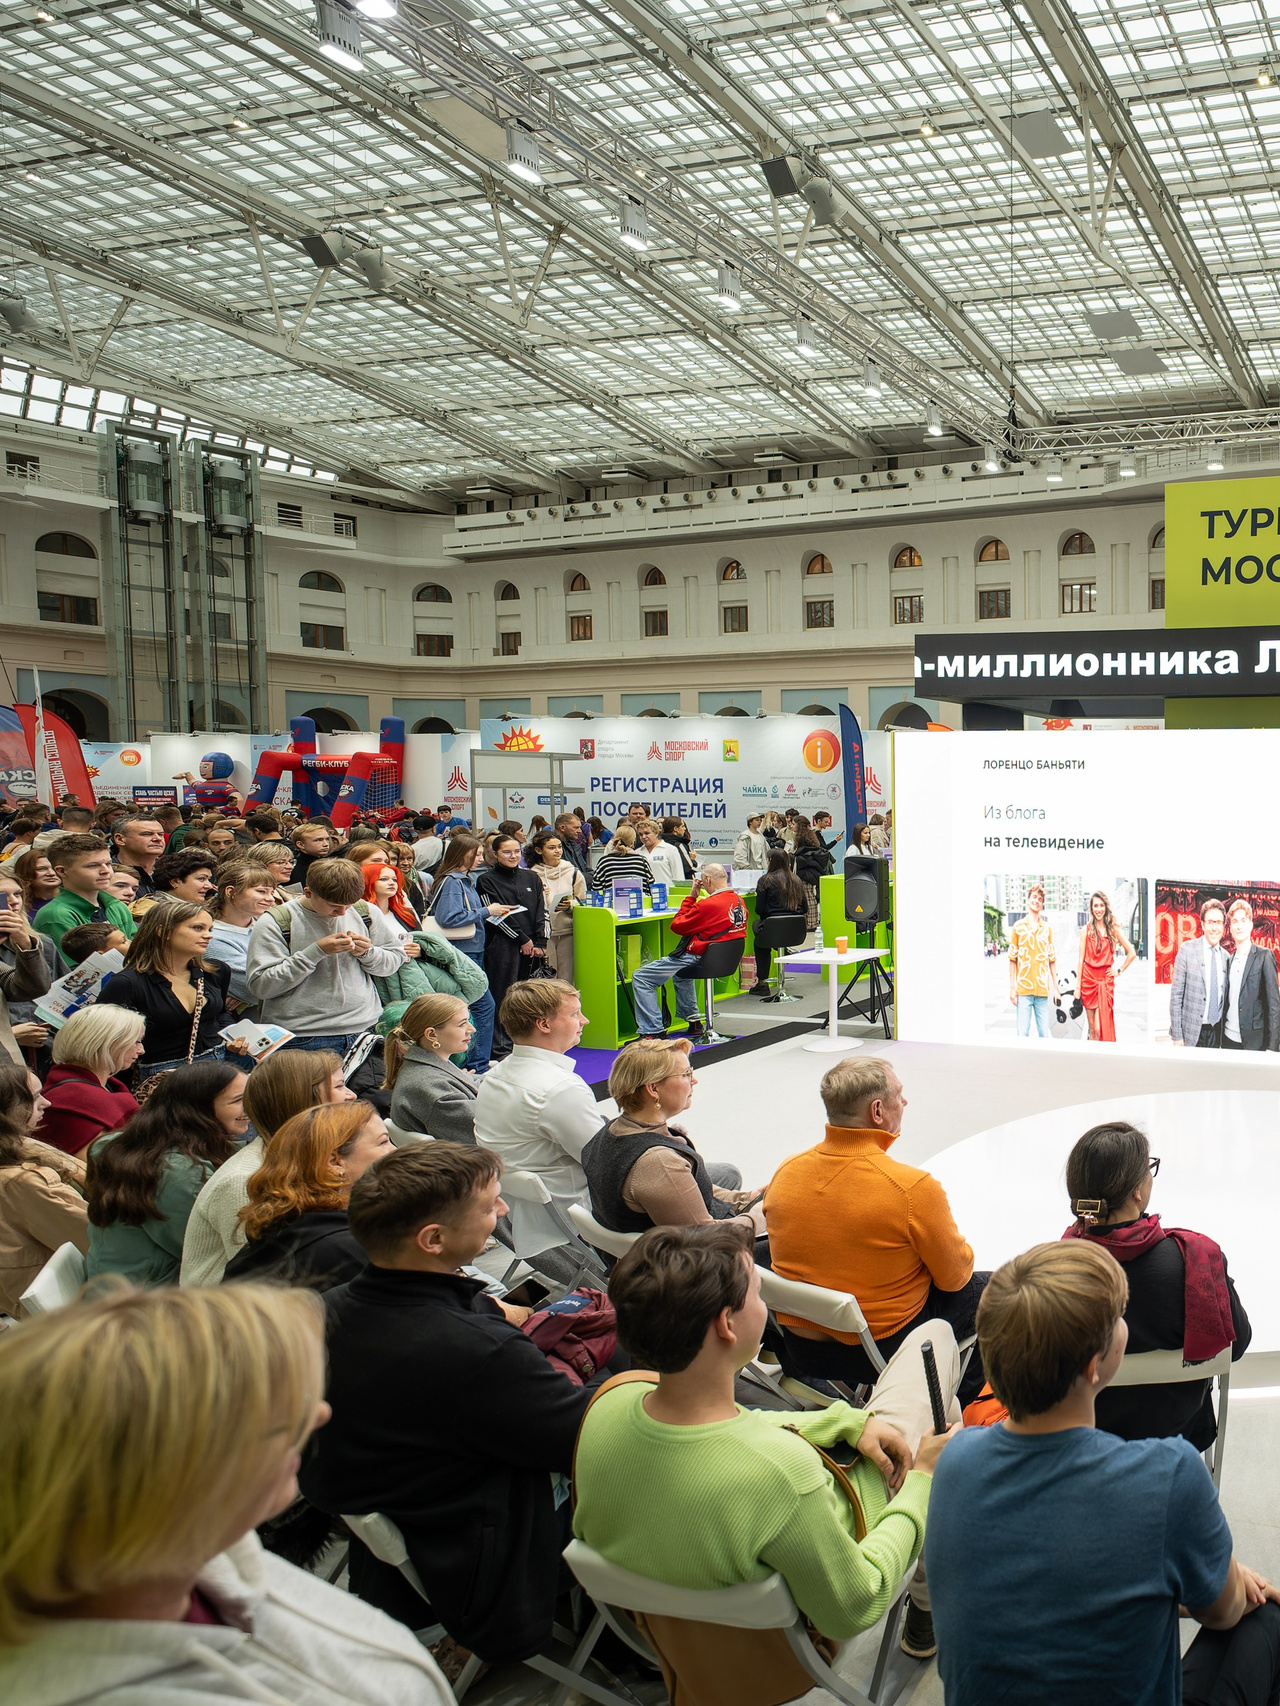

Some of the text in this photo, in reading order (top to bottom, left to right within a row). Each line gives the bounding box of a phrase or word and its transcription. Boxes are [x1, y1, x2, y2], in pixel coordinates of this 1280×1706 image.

[664, 739, 709, 751] МОСКОВСКИЙ
[664, 751, 686, 762] СПОРТ
[302, 759, 349, 768] РЕГБИ-КЛУБ
[983, 760, 1085, 771] ЛОРЕНЦО БАНЬЯТИ
[590, 777, 724, 796] РЕГИСТРАЦИЯ
[742, 784, 768, 793] ЧАЙКА
[591, 799, 727, 819] ПОСИТЕЛЕЙ
[984, 804, 1046, 819] Из блога
[984, 836, 1105, 851] на телевидение
